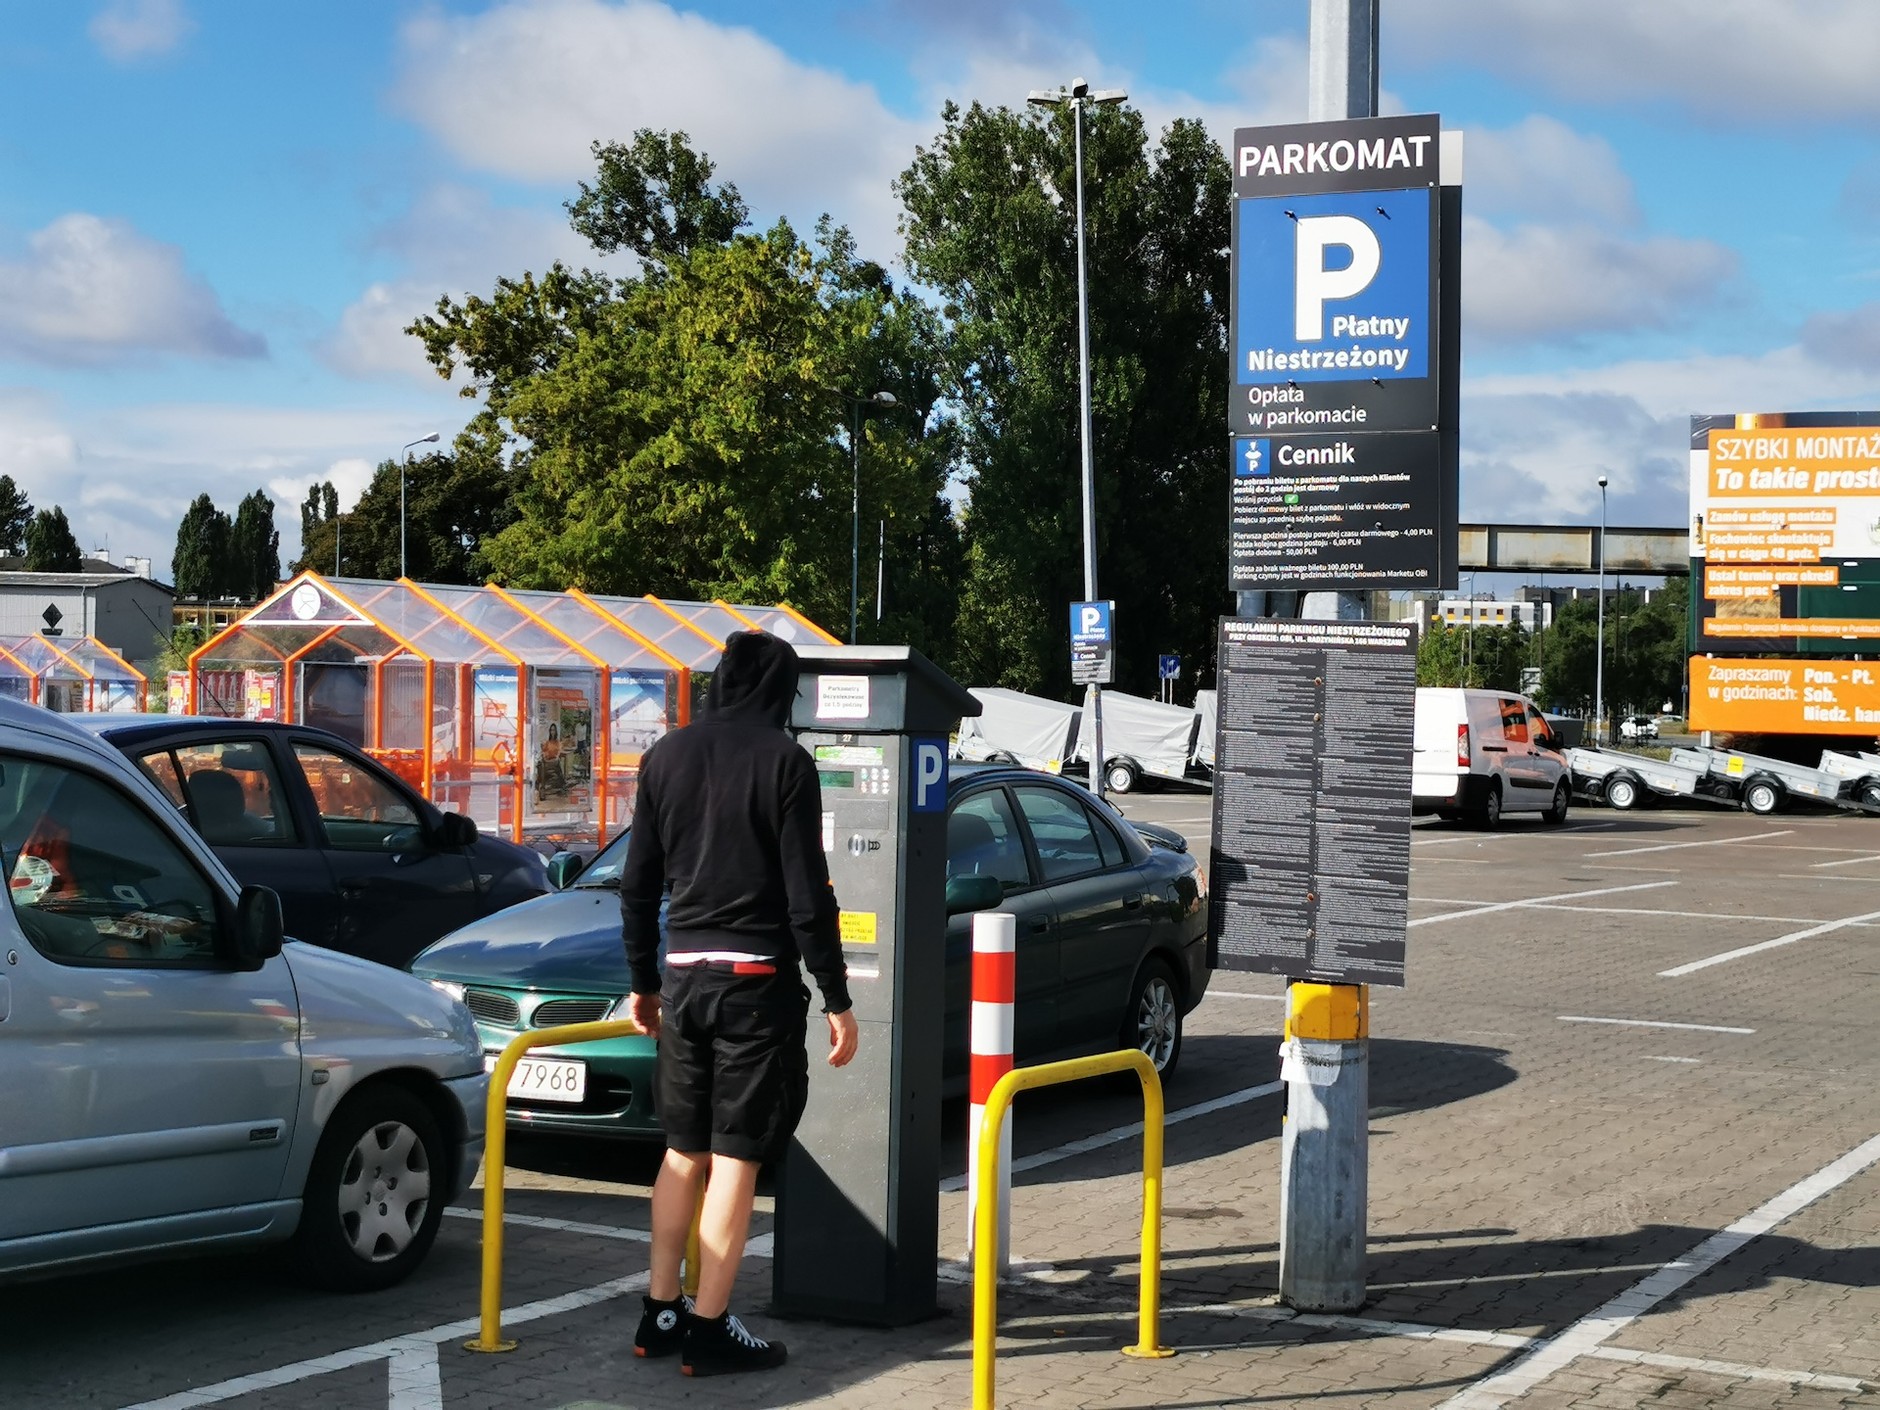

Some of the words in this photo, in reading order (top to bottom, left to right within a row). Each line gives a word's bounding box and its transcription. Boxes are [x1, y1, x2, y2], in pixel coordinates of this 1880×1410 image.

[1239, 136, 1431, 177] PARKOMAT
[1296, 216, 1380, 340] P
[1333, 315, 1409, 340] Płatny
[1249, 344, 1408, 371] Niestrzeżony
[1249, 386, 1304, 406] Opłata
[1248, 412, 1263, 425] w
[1266, 406, 1367, 428] parkomacie
[1278, 442, 1355, 466] Cennik
[1716, 437, 1789, 461] SZYBKI
[1244, 477, 1274, 486] pobraniu
[1300, 476, 1338, 485] parkomatu
[1350, 474, 1378, 483] naszych
[1379, 473, 1411, 481] Klientów
[1716, 468, 1744, 490] To
[1749, 466, 1809, 489] takie
[1814, 466, 1880, 493] prost
[1233, 485, 1255, 494] postój
[1270, 485, 1293, 494] godzin
[1294, 484, 1306, 493] jest
[1307, 484, 1340, 492] darmowy
[1258, 505, 1288, 513] darmowy
[1289, 504, 1303, 512] bilet
[1309, 503, 1344, 512] parkomatu
[1349, 502, 1365, 510] włóż
[1372, 502, 1410, 510] widocznym
[1233, 516, 1258, 525] miejscu
[1267, 515, 1295, 525] przednią
[1296, 515, 1313, 524] szybę
[1314, 513, 1343, 523] pojazdu.
[1233, 540, 1253, 548] Każda
[1254, 539, 1277, 548] kolejna
[1278, 539, 1303, 548] godzina
[1304, 538, 1328, 547] postoju
[1348, 538, 1361, 546] PLN
[1263, 531, 1288, 540] godzina
[1288, 531, 1312, 539] postoju
[1313, 530, 1340, 539] powyżej
[1360, 529, 1399, 538] darmowego
[1404, 529, 1418, 537] 4,00
[1233, 549, 1255, 557] Opłata
[1255, 548, 1281, 556] dobowa
[1727, 550, 1738, 558] w
[1233, 565, 1255, 573] Opłata
[1264, 564, 1278, 572] brak
[1279, 564, 1307, 573] ważnego
[1233, 572, 1257, 581] Parking
[1258, 572, 1280, 580] czynny
[1281, 572, 1292, 580] jest
[1300, 571, 1333, 580] godzinach
[1334, 570, 1386, 579] funkcjonowania
[1387, 569, 1414, 577] Marketu
[1415, 569, 1428, 577] OBI
[1082, 607, 1101, 634] P
[1224, 622, 1277, 632] REGULAMIN
[1278, 623, 1326, 634] PARKINGU
[1327, 625, 1411, 638] NIESTRZEŻONEGO
[1708, 665, 1792, 684] Zapraszamy
[1804, 668, 1838, 684] Pon.
[1852, 669, 1875, 684] Pt.
[1708, 687, 1720, 699] w
[1723, 685, 1797, 703] godzinach:
[1803, 687, 1837, 703] Sob.
[1803, 705, 1851, 722] Niedz.
[917, 744, 943, 806] P
[521, 1063, 577, 1091] 7968
